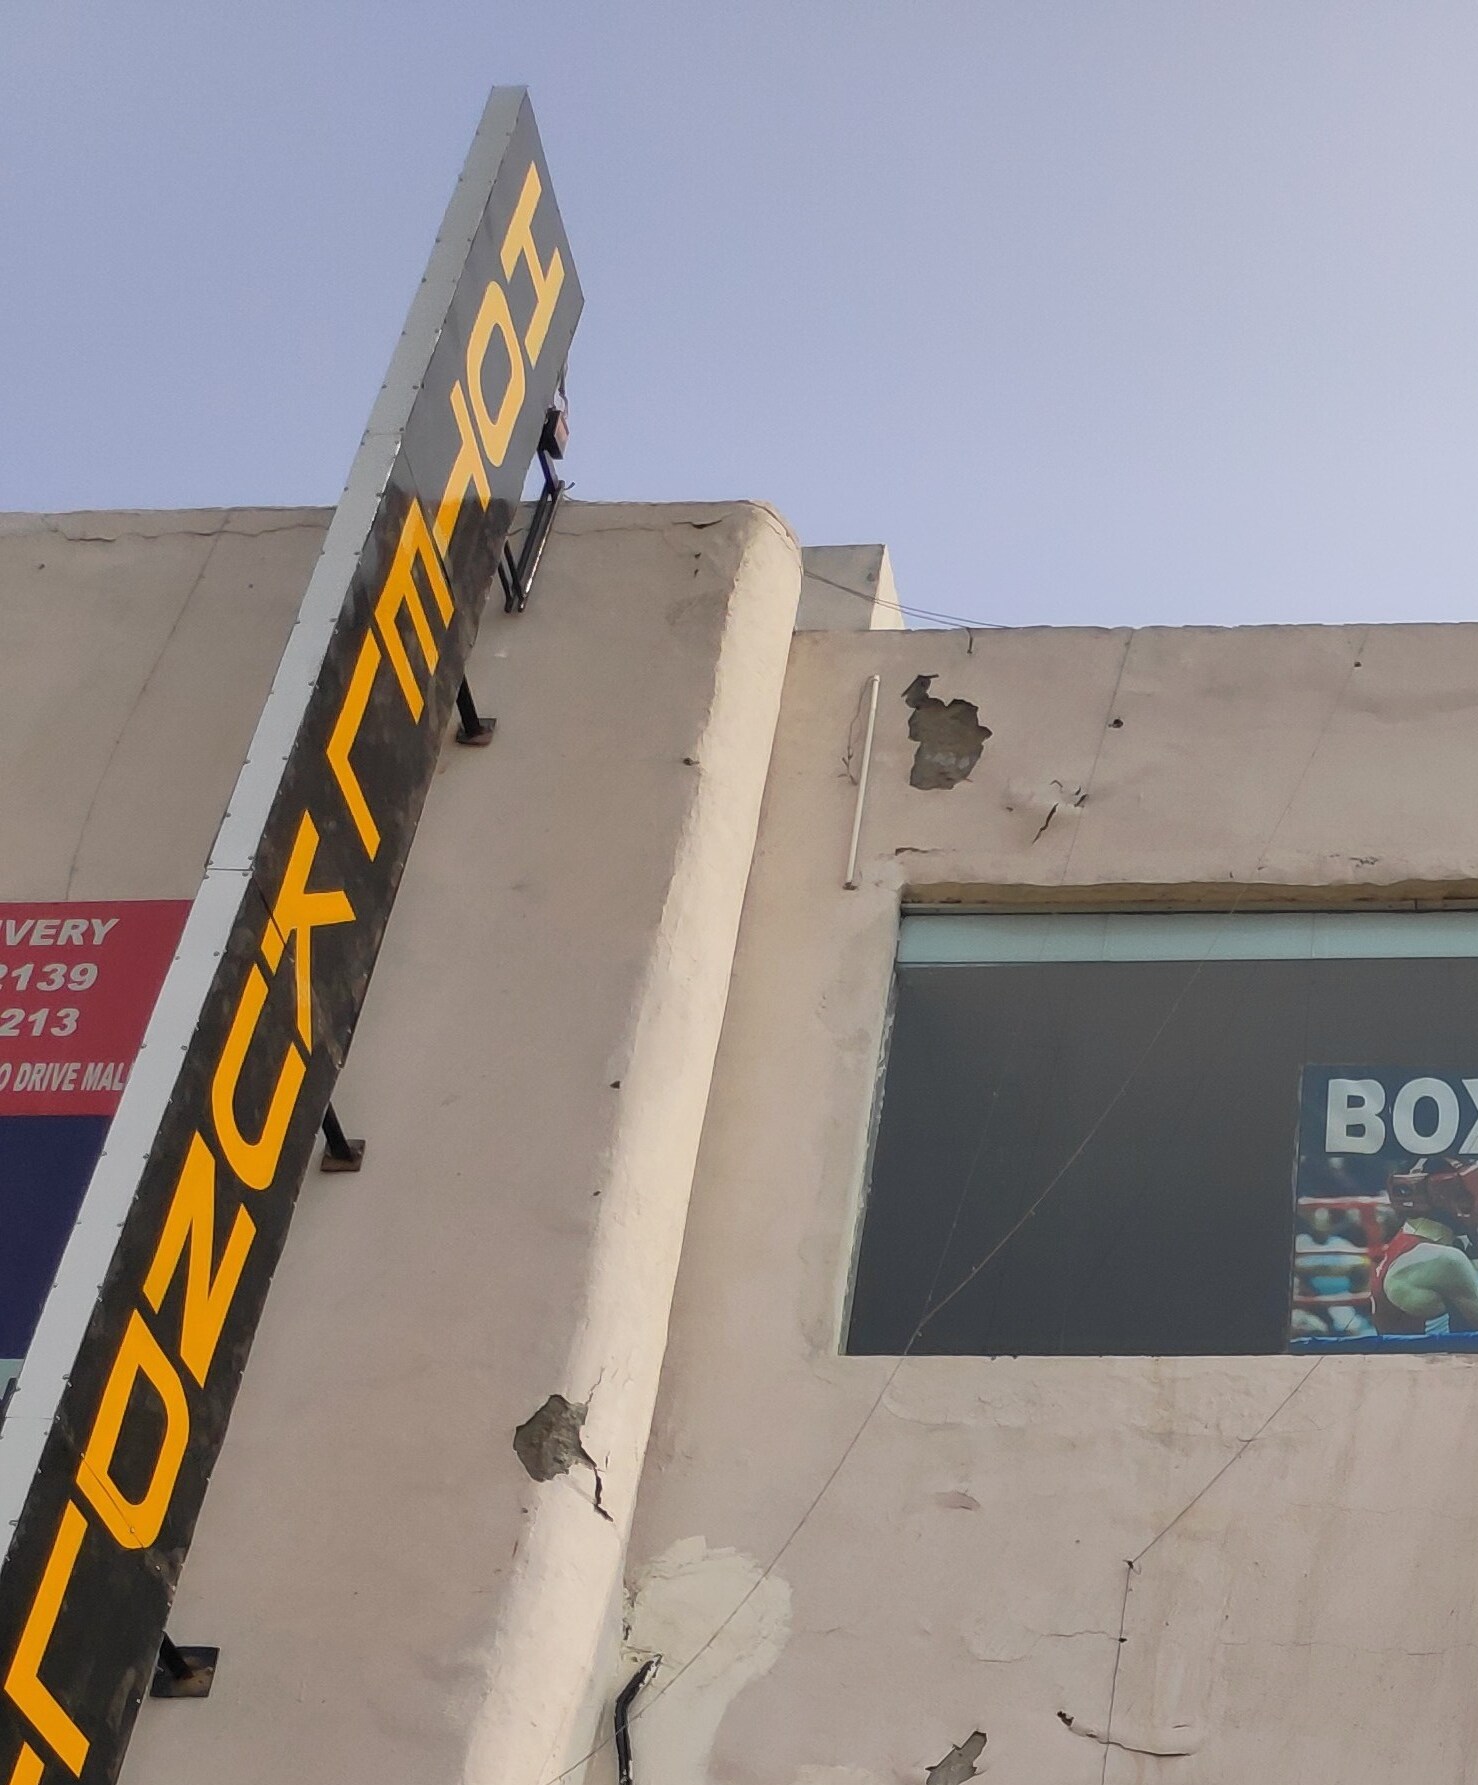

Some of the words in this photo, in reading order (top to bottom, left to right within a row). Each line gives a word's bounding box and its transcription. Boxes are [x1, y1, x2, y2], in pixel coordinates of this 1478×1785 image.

[326, 159, 565, 863] HOTEL
[0, 918, 119, 946] VERY
[13, 1062, 81, 1092] DRIVE
